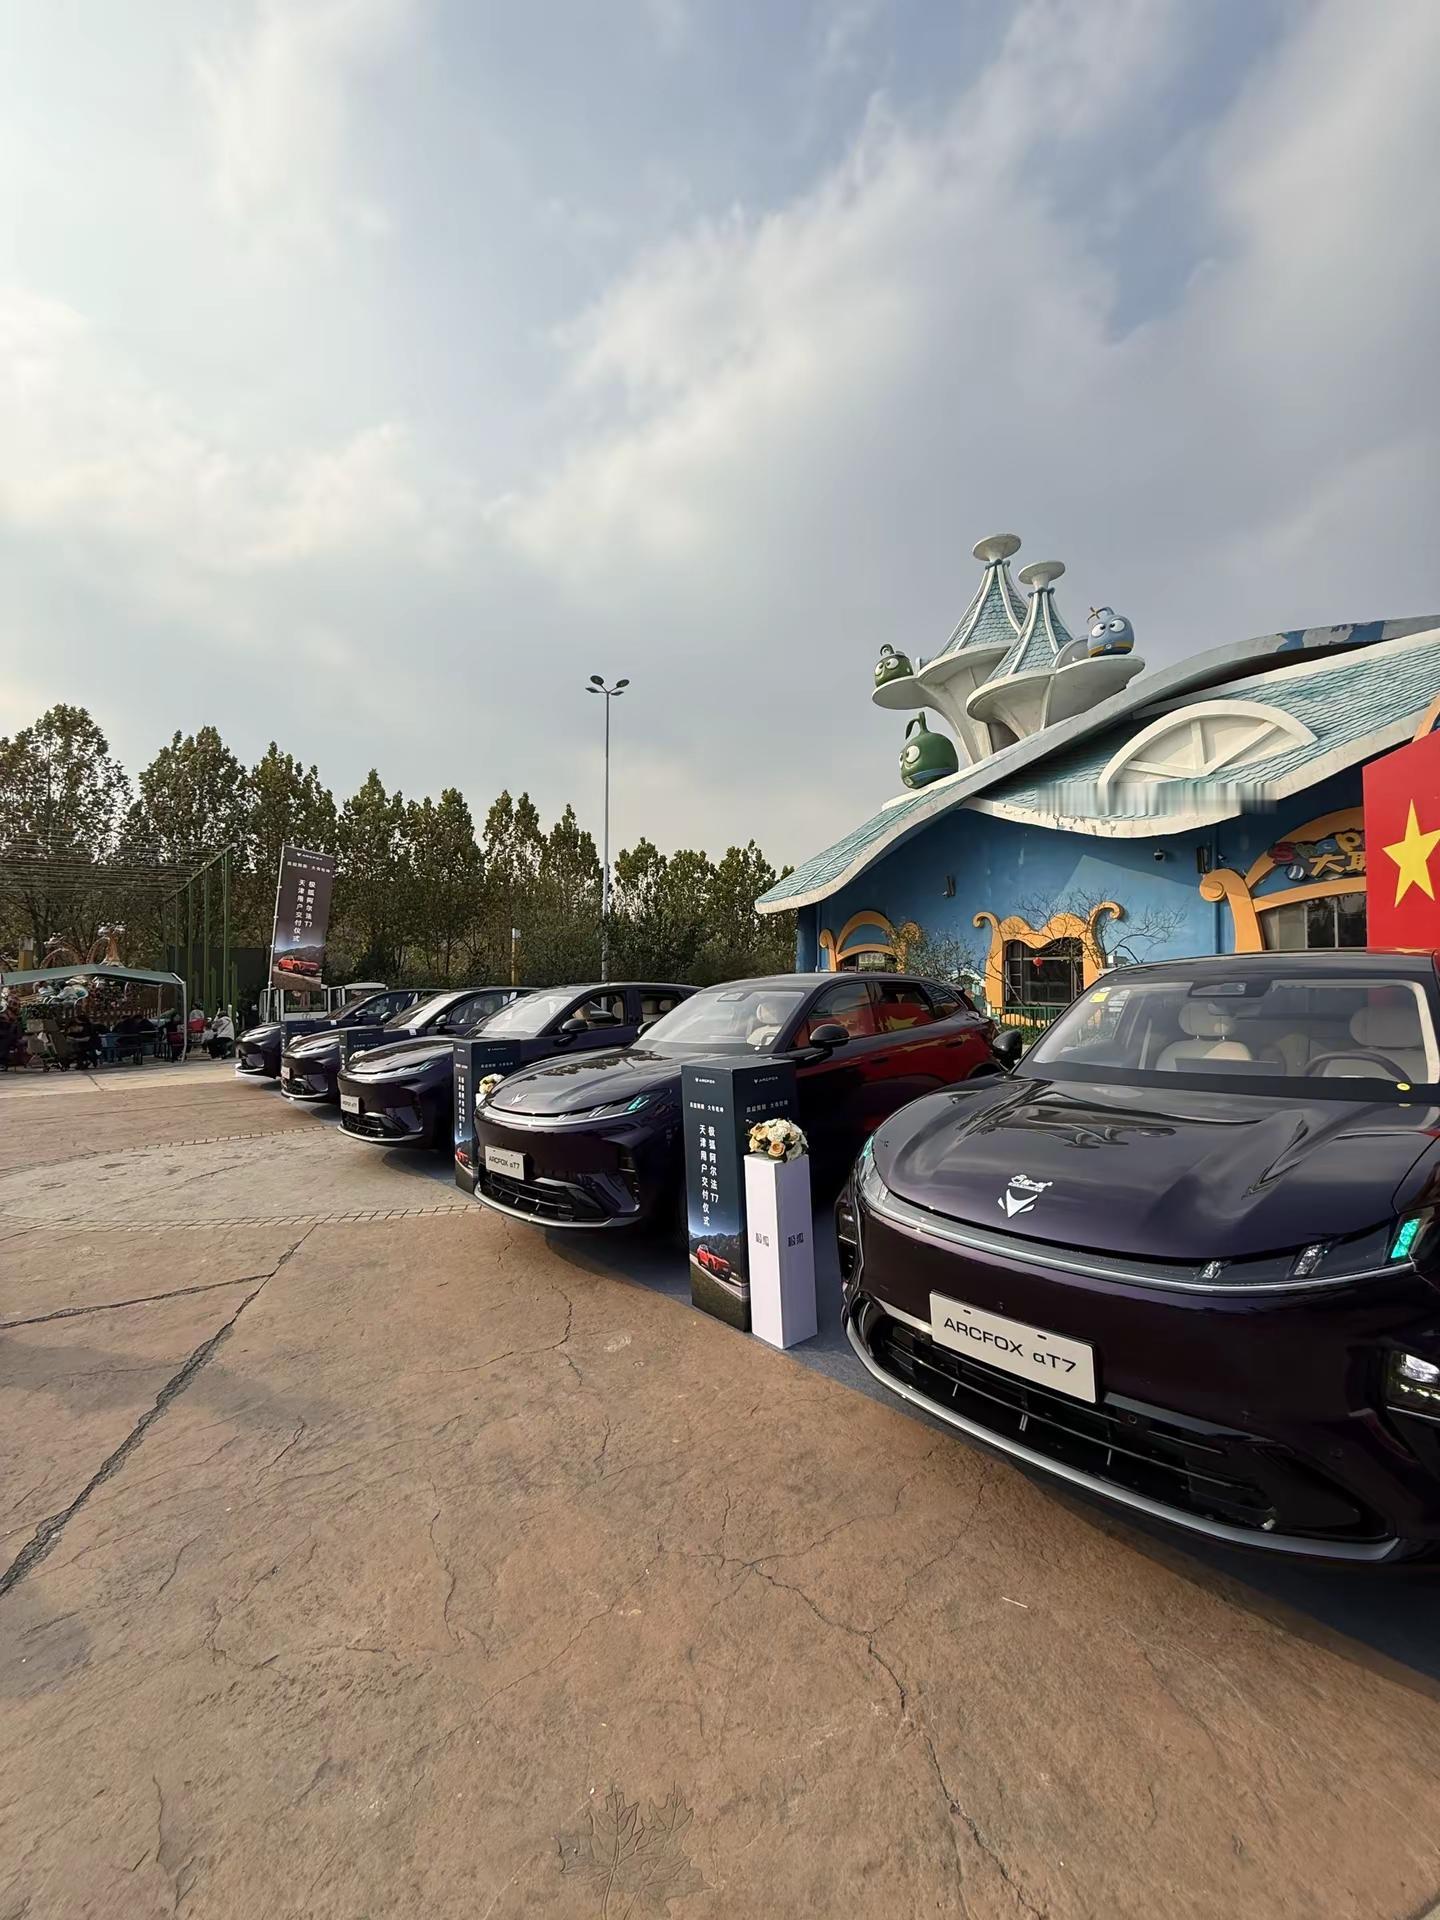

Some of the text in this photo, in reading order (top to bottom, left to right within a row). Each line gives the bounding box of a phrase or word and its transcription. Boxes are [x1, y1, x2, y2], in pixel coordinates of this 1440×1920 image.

[699, 1124, 710, 1227] 天津用户交付仪式
[708, 1126, 719, 1203] 极狐阿尔法T7
[943, 1317, 1024, 1357] ARCFOX
